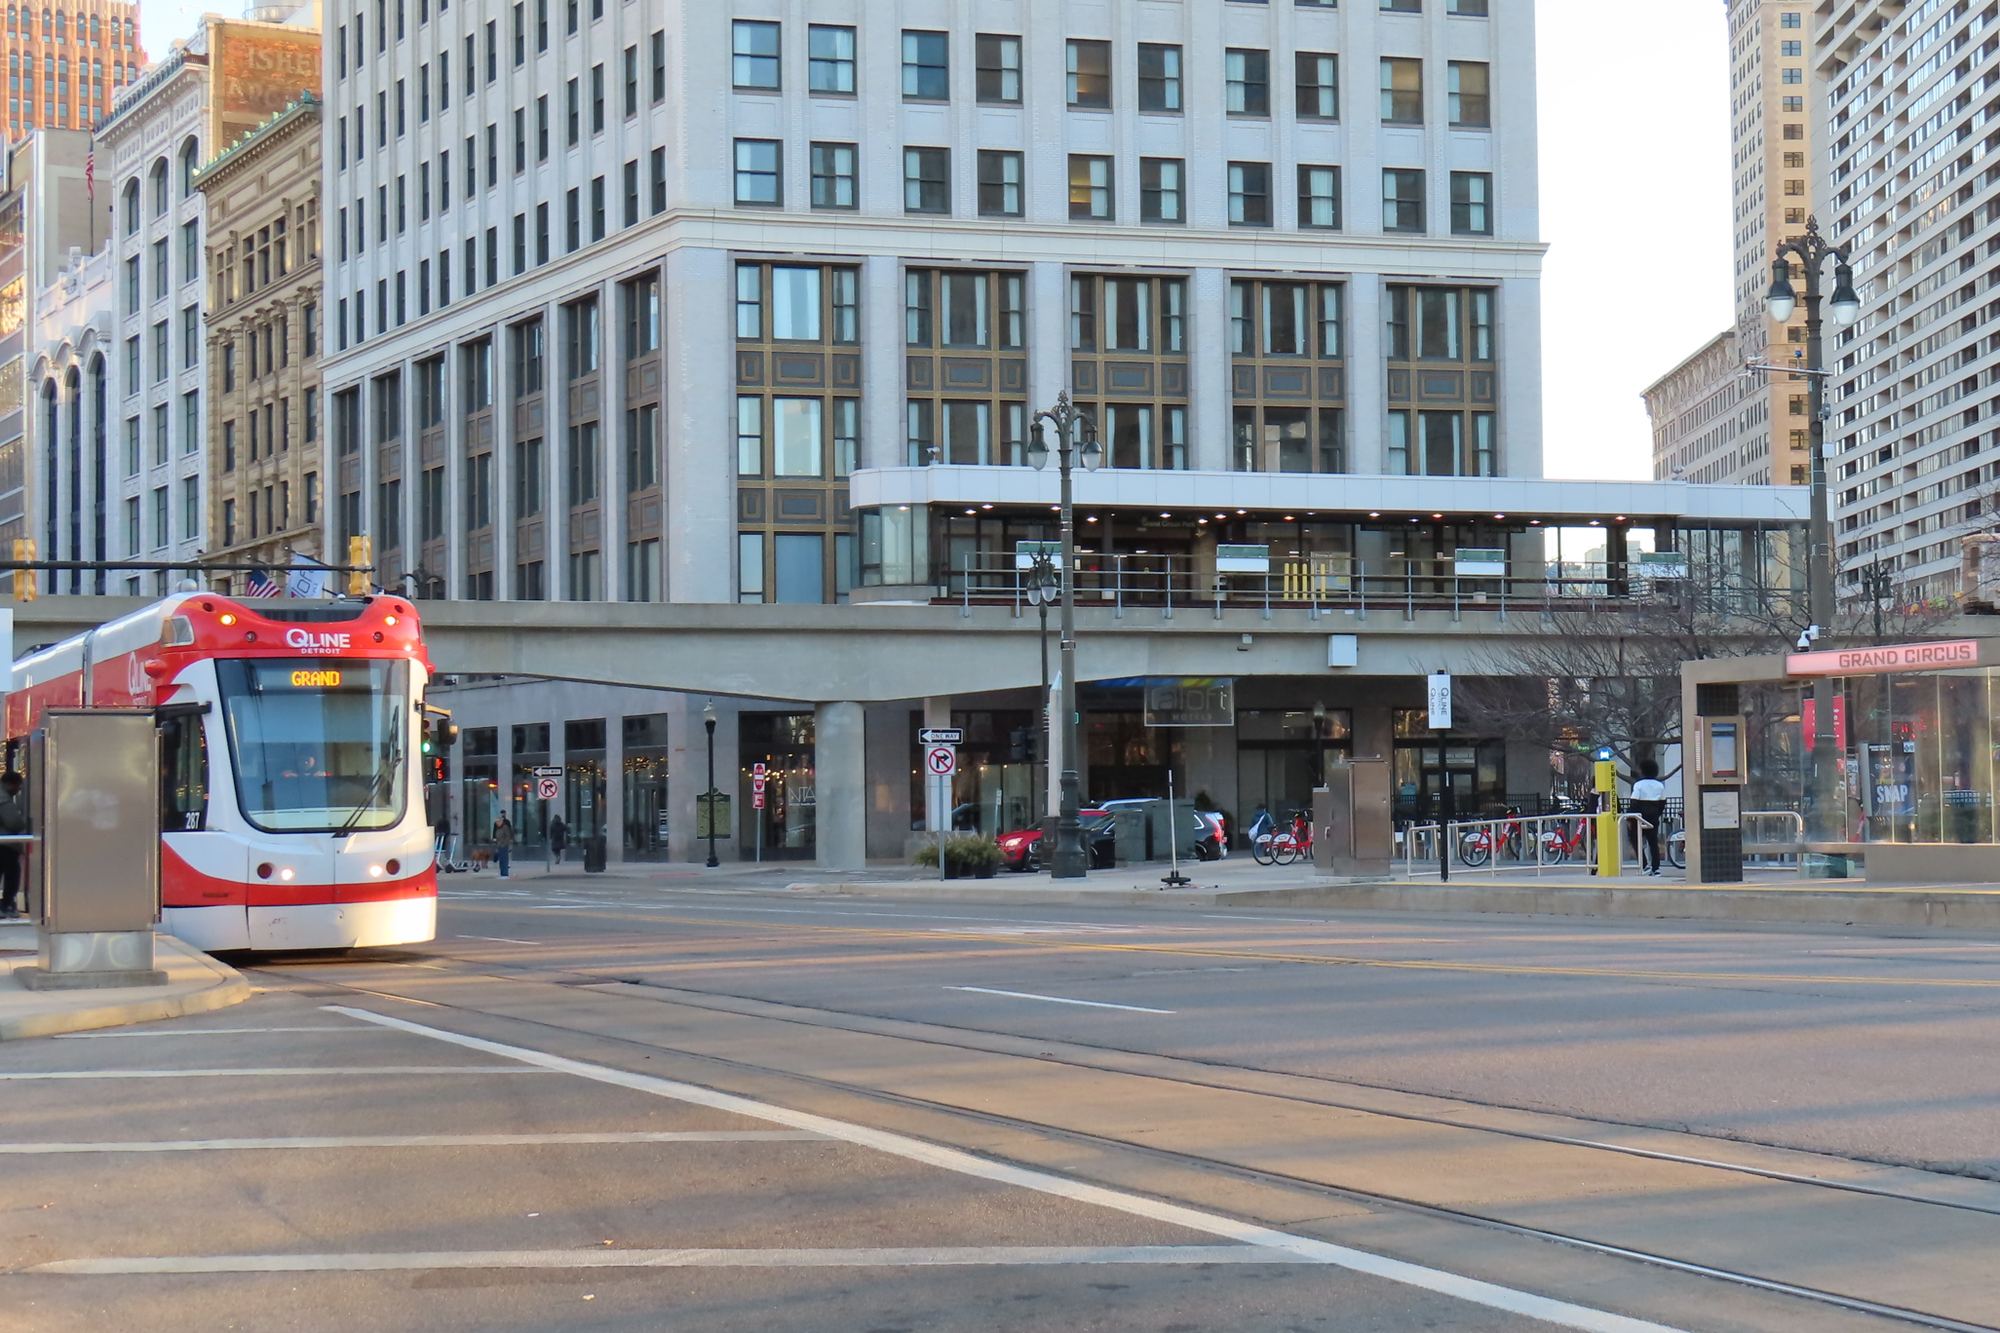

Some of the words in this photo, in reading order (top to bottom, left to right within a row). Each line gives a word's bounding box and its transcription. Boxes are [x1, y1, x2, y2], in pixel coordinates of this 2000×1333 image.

[286, 628, 351, 648] QLINE
[1839, 650, 1898, 668] GRAND
[1905, 645, 1971, 664] CIRCUS
[291, 671, 340, 686] GRAND
[185, 811, 200, 830] 287
